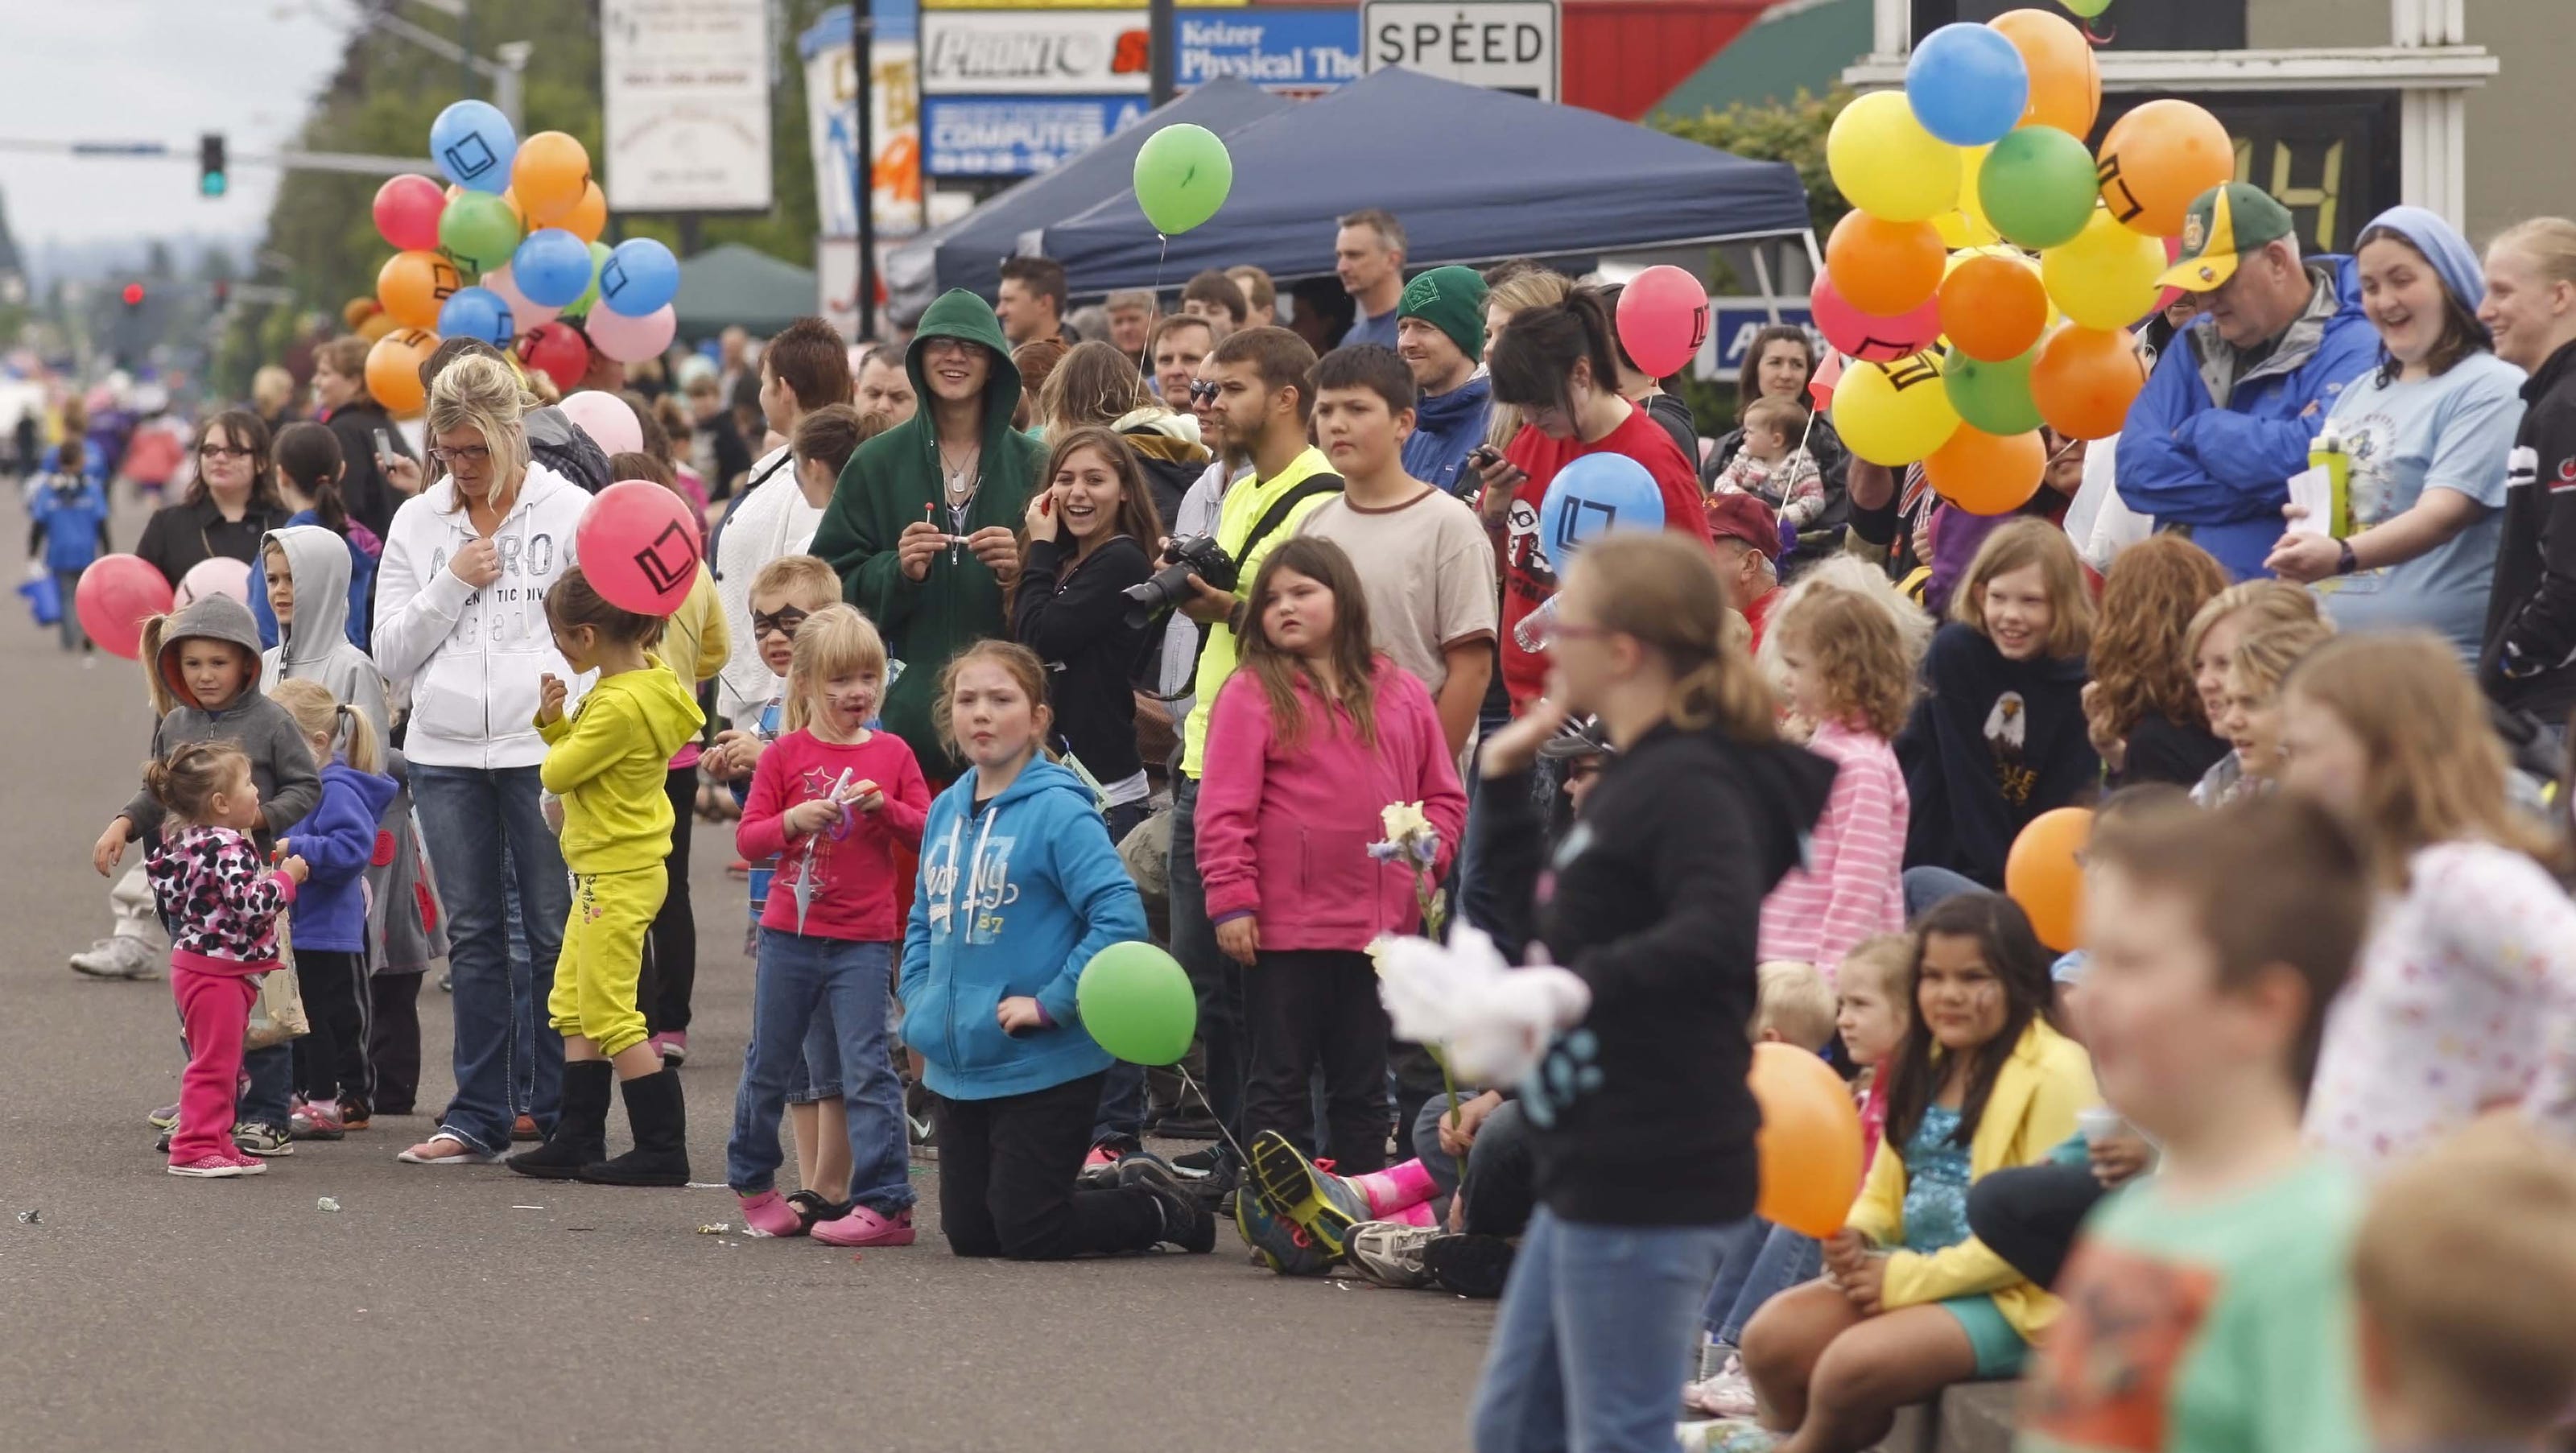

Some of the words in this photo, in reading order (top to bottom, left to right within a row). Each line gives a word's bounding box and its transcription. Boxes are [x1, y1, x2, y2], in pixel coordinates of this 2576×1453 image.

[1181, 19, 1265, 47] Keizer
[1379, 23, 1543, 64] SPEED
[929, 29, 1101, 76] PRONTO
[1181, 48, 1304, 79] Physical
[977, 912, 1005, 934] 87
